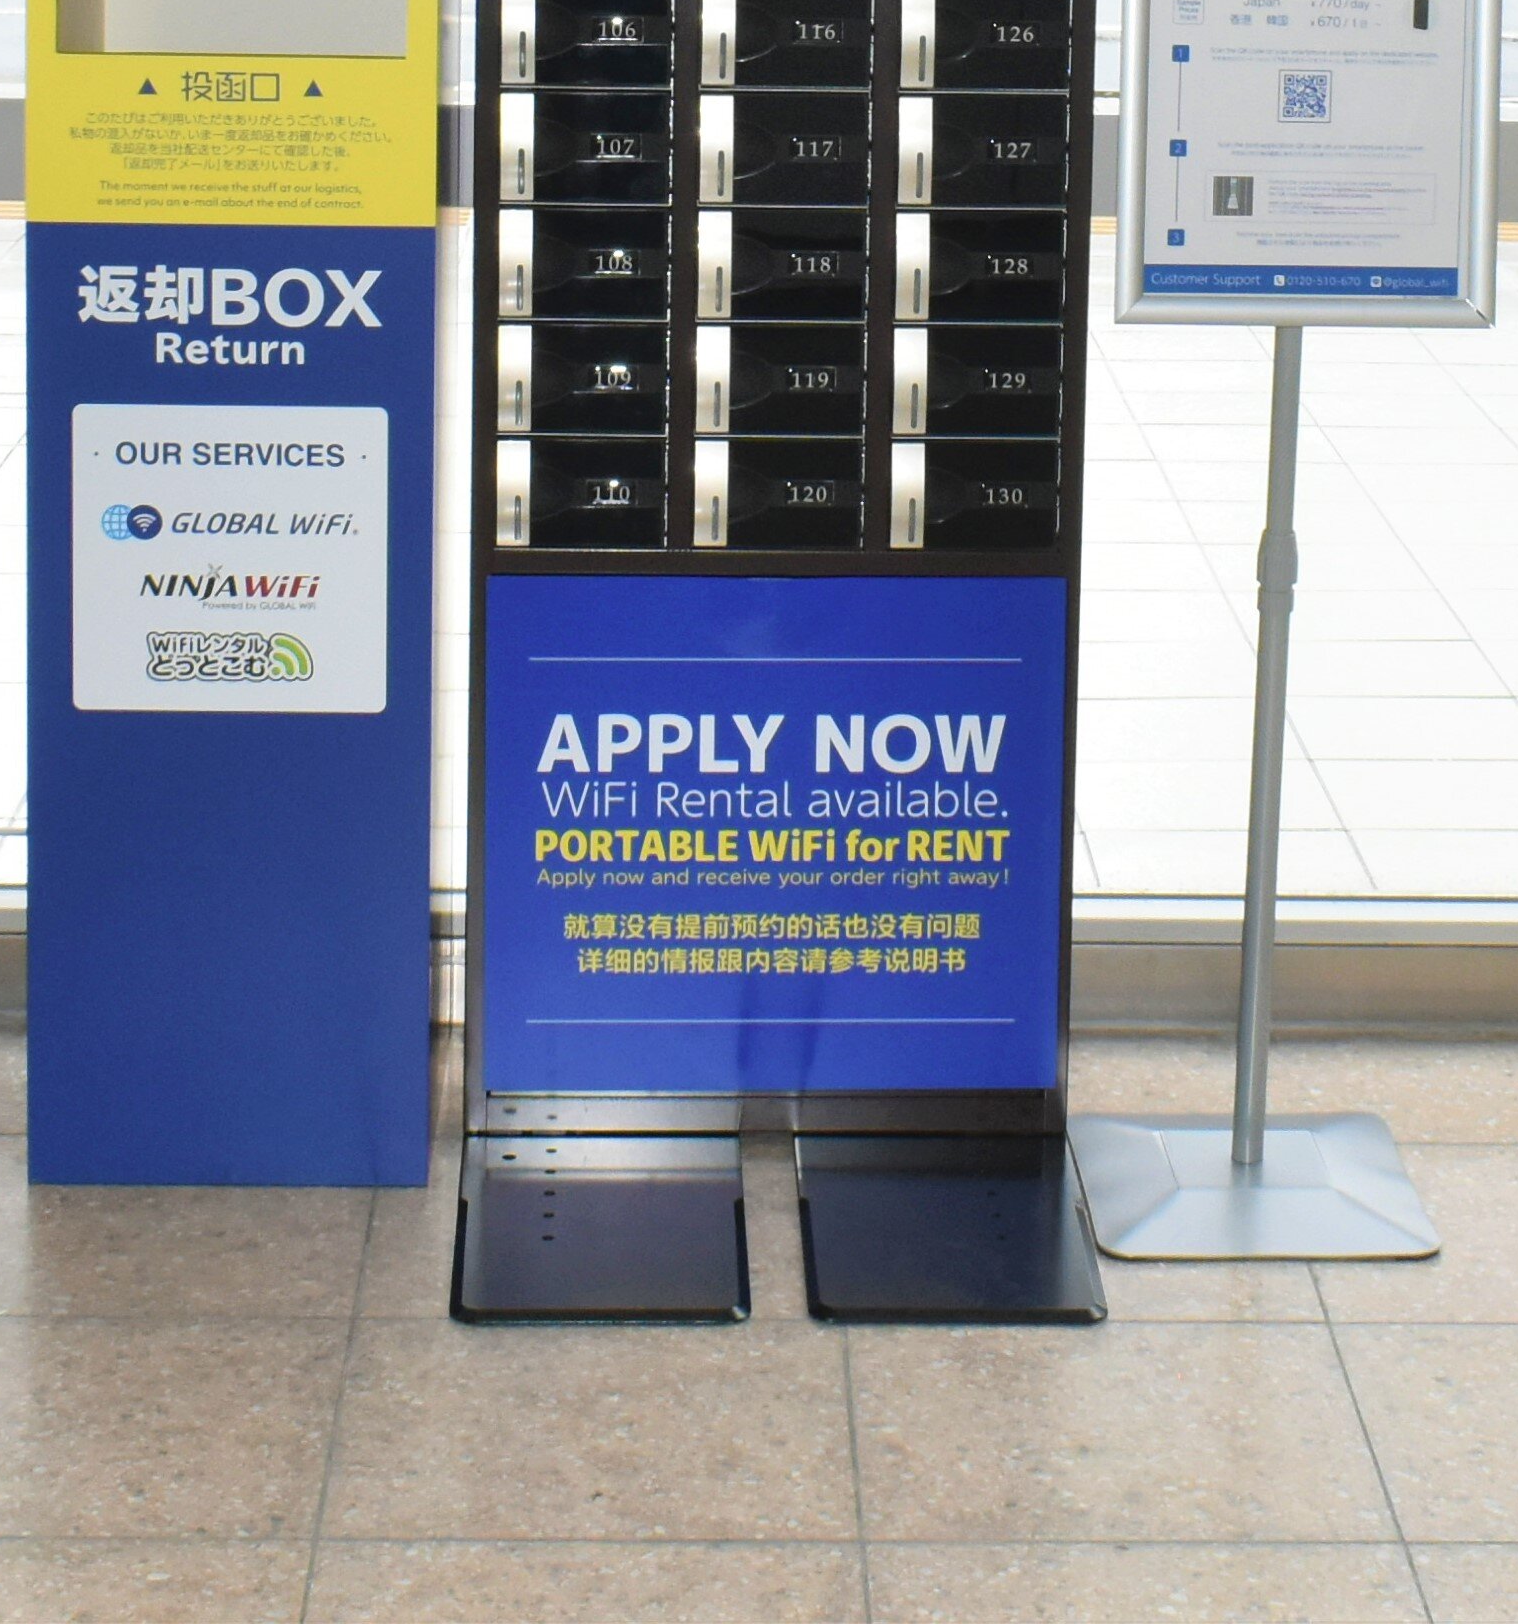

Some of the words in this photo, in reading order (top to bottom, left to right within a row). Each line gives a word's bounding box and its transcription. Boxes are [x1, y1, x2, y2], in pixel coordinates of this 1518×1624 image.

[597, 19, 636, 39] 106
[797, 23, 836, 41] 116
[995, 25, 1035, 43] 126
[181, 70, 280, 103] 投函口
[596, 138, 635, 156] 107
[795, 140, 834, 158] 117
[993, 141, 1032, 160] 127
[100, 180, 120, 191] The
[123, 182, 169, 191] moment
[172, 183, 186, 191] we
[189, 181, 228, 192] receive
[232, 181, 249, 192] the
[252, 181, 277, 193] stuff
[280, 183, 291, 193] at
[294, 184, 311, 193] our
[315, 182, 362, 197] logistics,
[595, 253, 633, 272] 108
[792, 255, 831, 273] 118
[990, 257, 1029, 276] 128
[1152, 273, 1208, 285] Customer
[1213, 273, 1261, 287] Support
[78, 265, 382, 328] 返却BOX
[156, 332, 306, 365] Return
[594, 369, 632, 388] 109
[791, 371, 830, 390] 119
[987, 372, 1026, 391] 129
[116, 442, 181, 465] OUR
[193, 443, 345, 467] SERVICES
[591, 483, 631, 503] 110
[788, 485, 828, 503] 120
[984, 487, 1024, 506] 130
[172, 512, 279, 535] GLOBAL
[245, 575, 320, 598] WiFi
[202, 602, 243, 610] Powered
[246, 602, 256, 611] by
[260, 602, 296, 610] GLOBAL
[153, 654, 265, 676] どっとこむ
[537, 713, 784, 773] APPLY
[815, 714, 1006, 774] NOW
[542, 781, 637, 818] WiFi
[656, 781, 791, 818] Rental
[808, 782, 1008, 818] available.
[535, 829, 738, 862] PORTABLE
[749, 829, 835, 862] WiFi
[846, 829, 899, 862] for
[907, 829, 1010, 862] RENT
[537, 868, 595, 888] Apply
[603, 872, 643, 884] now
[651, 869, 689, 884] and
[697, 869, 771, 885] receive
[778, 872, 822, 889] your
[830, 869, 883, 885] order
[892, 869, 940, 889] right
[563, 913, 980, 940] 就算没有提前预约的话也没有问题
[577, 948, 966, 974] 详细的情报跟内容请参考说明书
